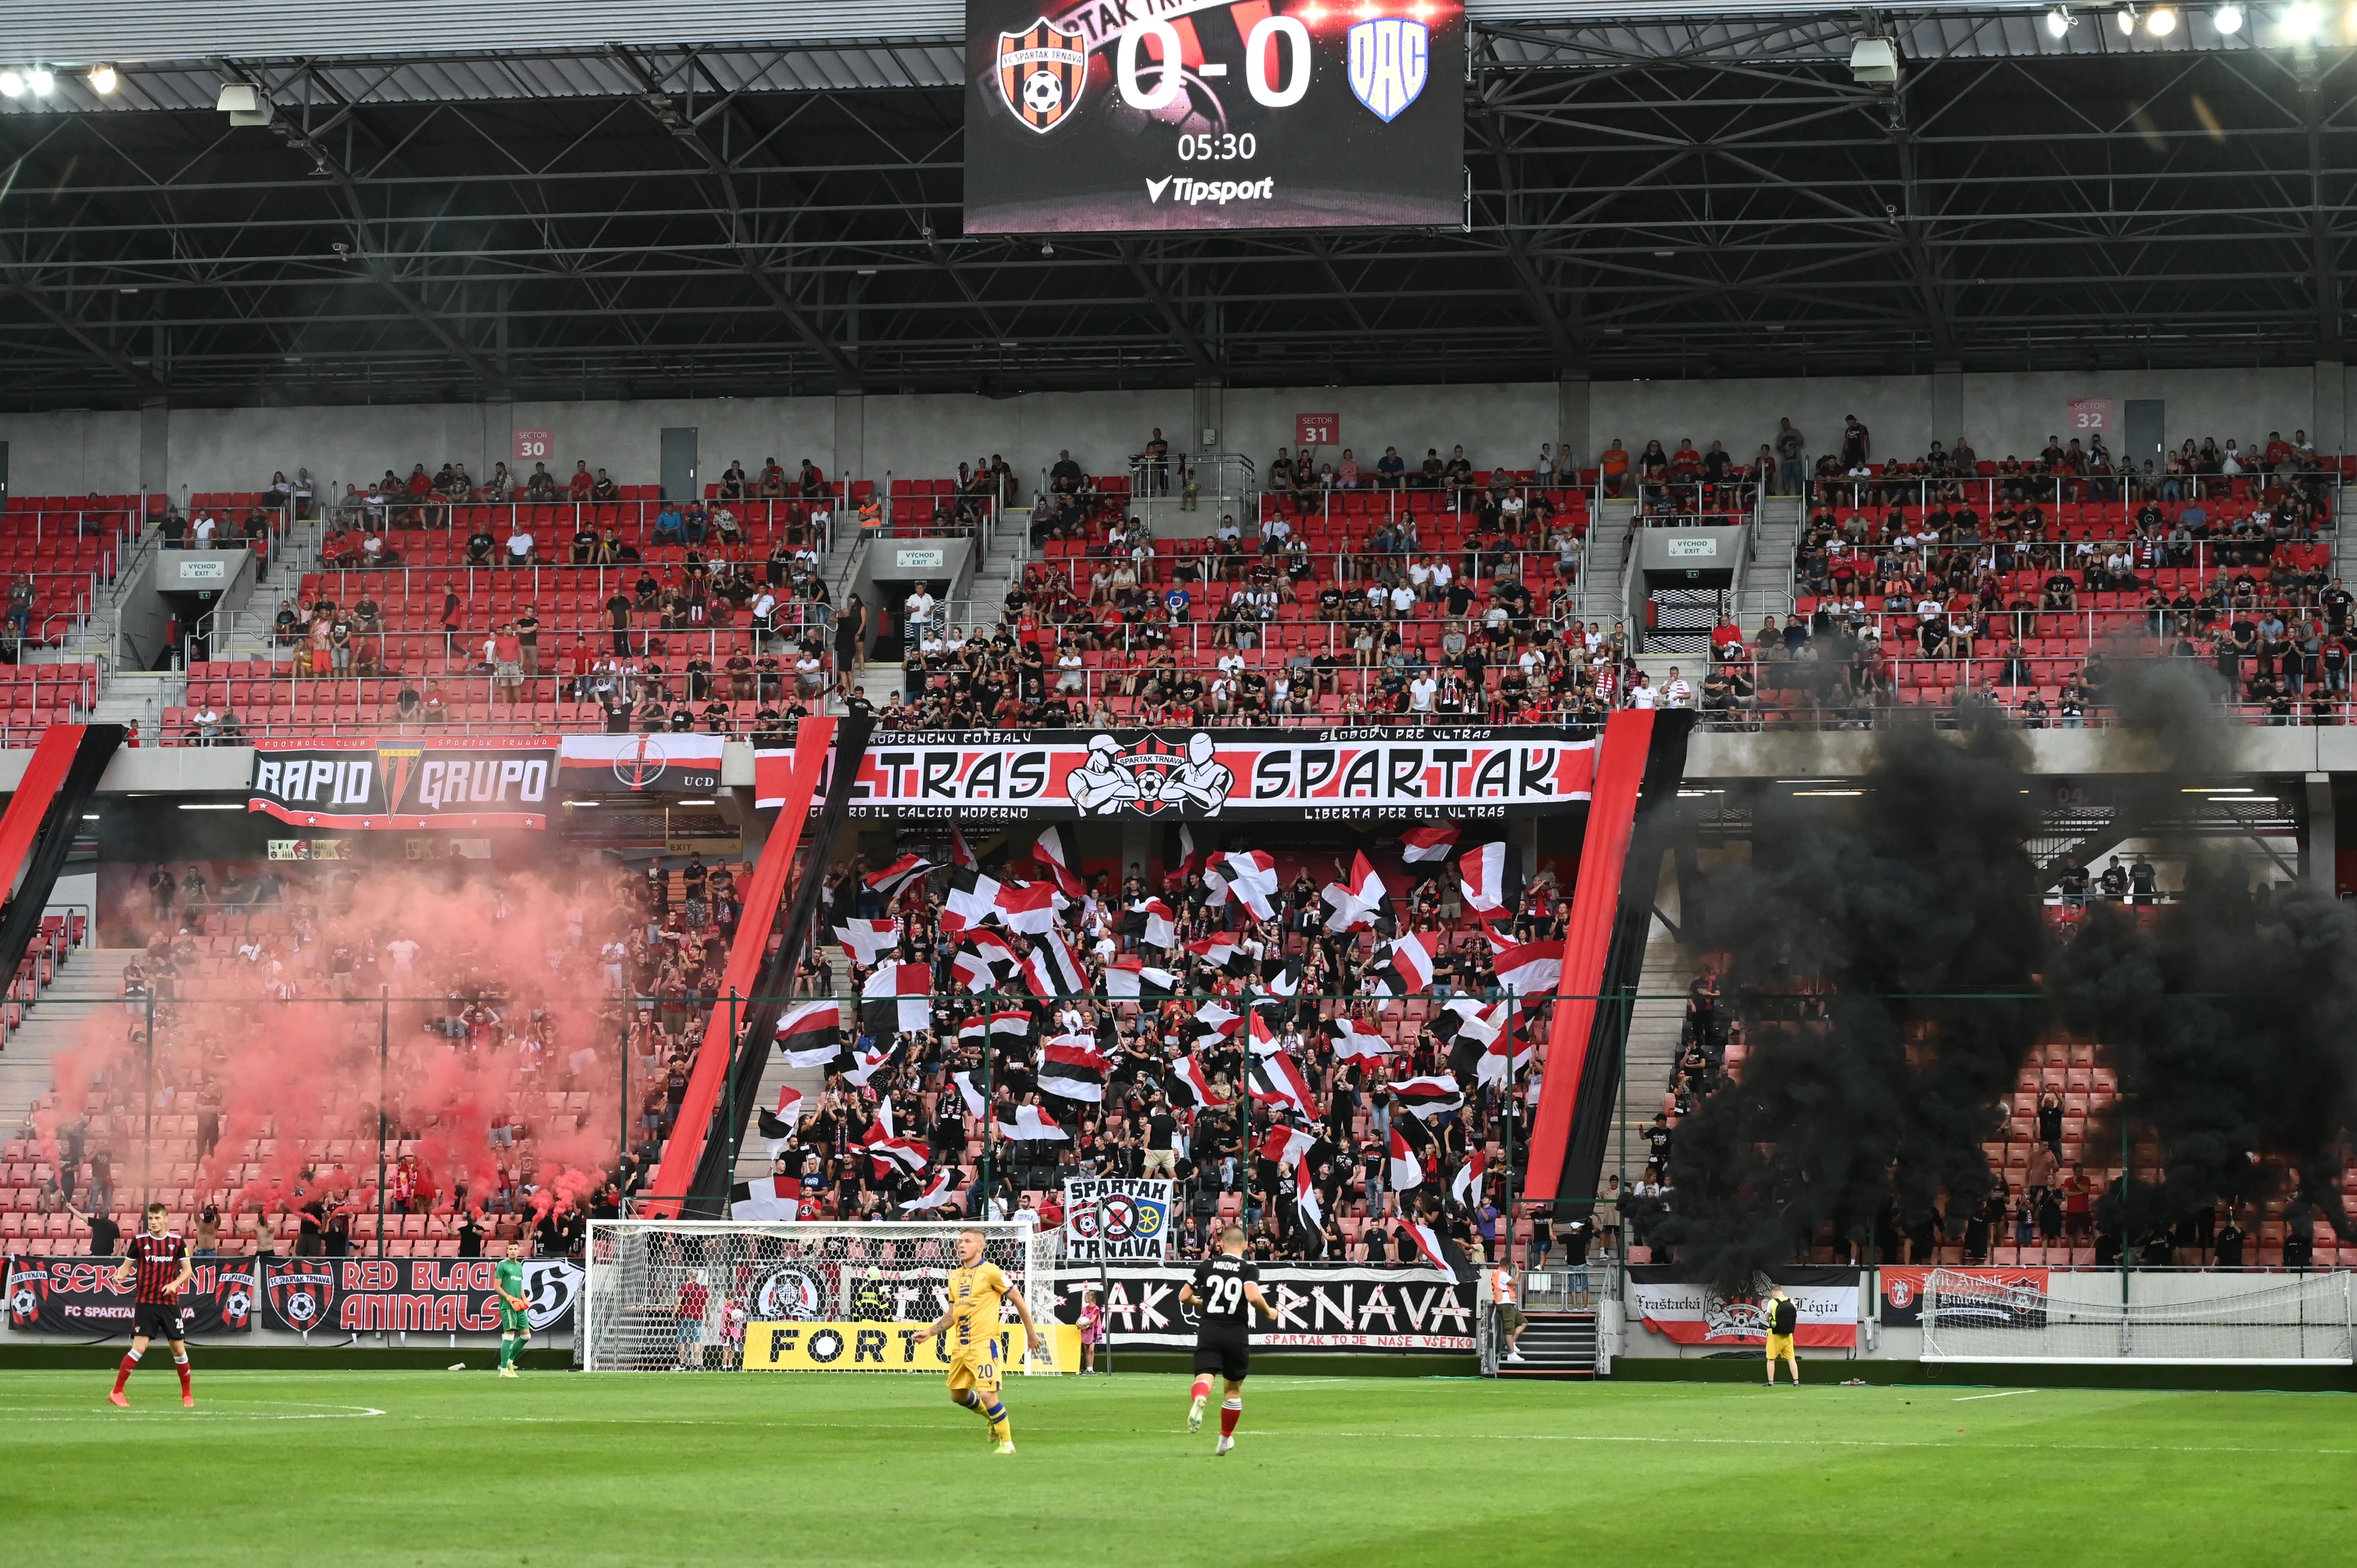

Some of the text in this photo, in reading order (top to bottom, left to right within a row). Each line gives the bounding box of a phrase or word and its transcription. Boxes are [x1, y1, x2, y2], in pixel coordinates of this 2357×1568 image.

[1004, 51, 1082, 64] FC SPARTAK TRNAVA
[1178, 133, 1256, 161] 05:30
[1173, 176, 1274, 205] Tipsport
[2074, 402, 2105, 410] SECTOR
[2077, 412, 2102, 428] 32
[519, 431, 548, 439] SECTOR
[1305, 427, 1327, 442] 31
[521, 442, 545, 456] 30
[1395, 728, 1425, 739] PRE
[265, 739, 366, 748] FOOTBALL CLUB
[438, 738, 548, 746] SPARTAK TRNAVA
[1119, 755, 1183, 765] SPARTAK TRNAVA
[813, 746, 1561, 799] TRAS SPARTAK
[252, 757, 548, 810] RAPID GRUPO
[684, 776, 715, 787] UCD
[874, 806, 889, 817] IL
[898, 806, 953, 817] CALCIO
[960, 807, 1029, 818] MODERNO
[1304, 807, 1371, 819] LIBERTA
[1378, 807, 1406, 818] PER
[1414, 806, 1440, 817] GLI
[670, 843, 693, 852] EXIT
[1070, 1180, 1168, 1200] SPARTAK
[1070, 1238, 1162, 1258] TRNAVA
[1212, 1260, 1241, 1272] MIKOVIČ
[25, 1271, 47, 1280] TRNAVA
[270, 1275, 332, 1285] FC SPARTAK TRNAVA
[342, 1261, 398, 1291] RED
[1205, 1274, 1243, 1315] 29
[65, 1305, 81, 1317] FC
[341, 1294, 502, 1331] ANIMALS
[175, 1318, 184, 1329] 26
[1332, 1334, 1348, 1346] TO
[1351, 1334, 1367, 1346] JE
[1378, 1333, 1413, 1347] NAŠE
[1424, 1334, 1473, 1348] VŠETKO
[977, 1363, 993, 1379] 20
